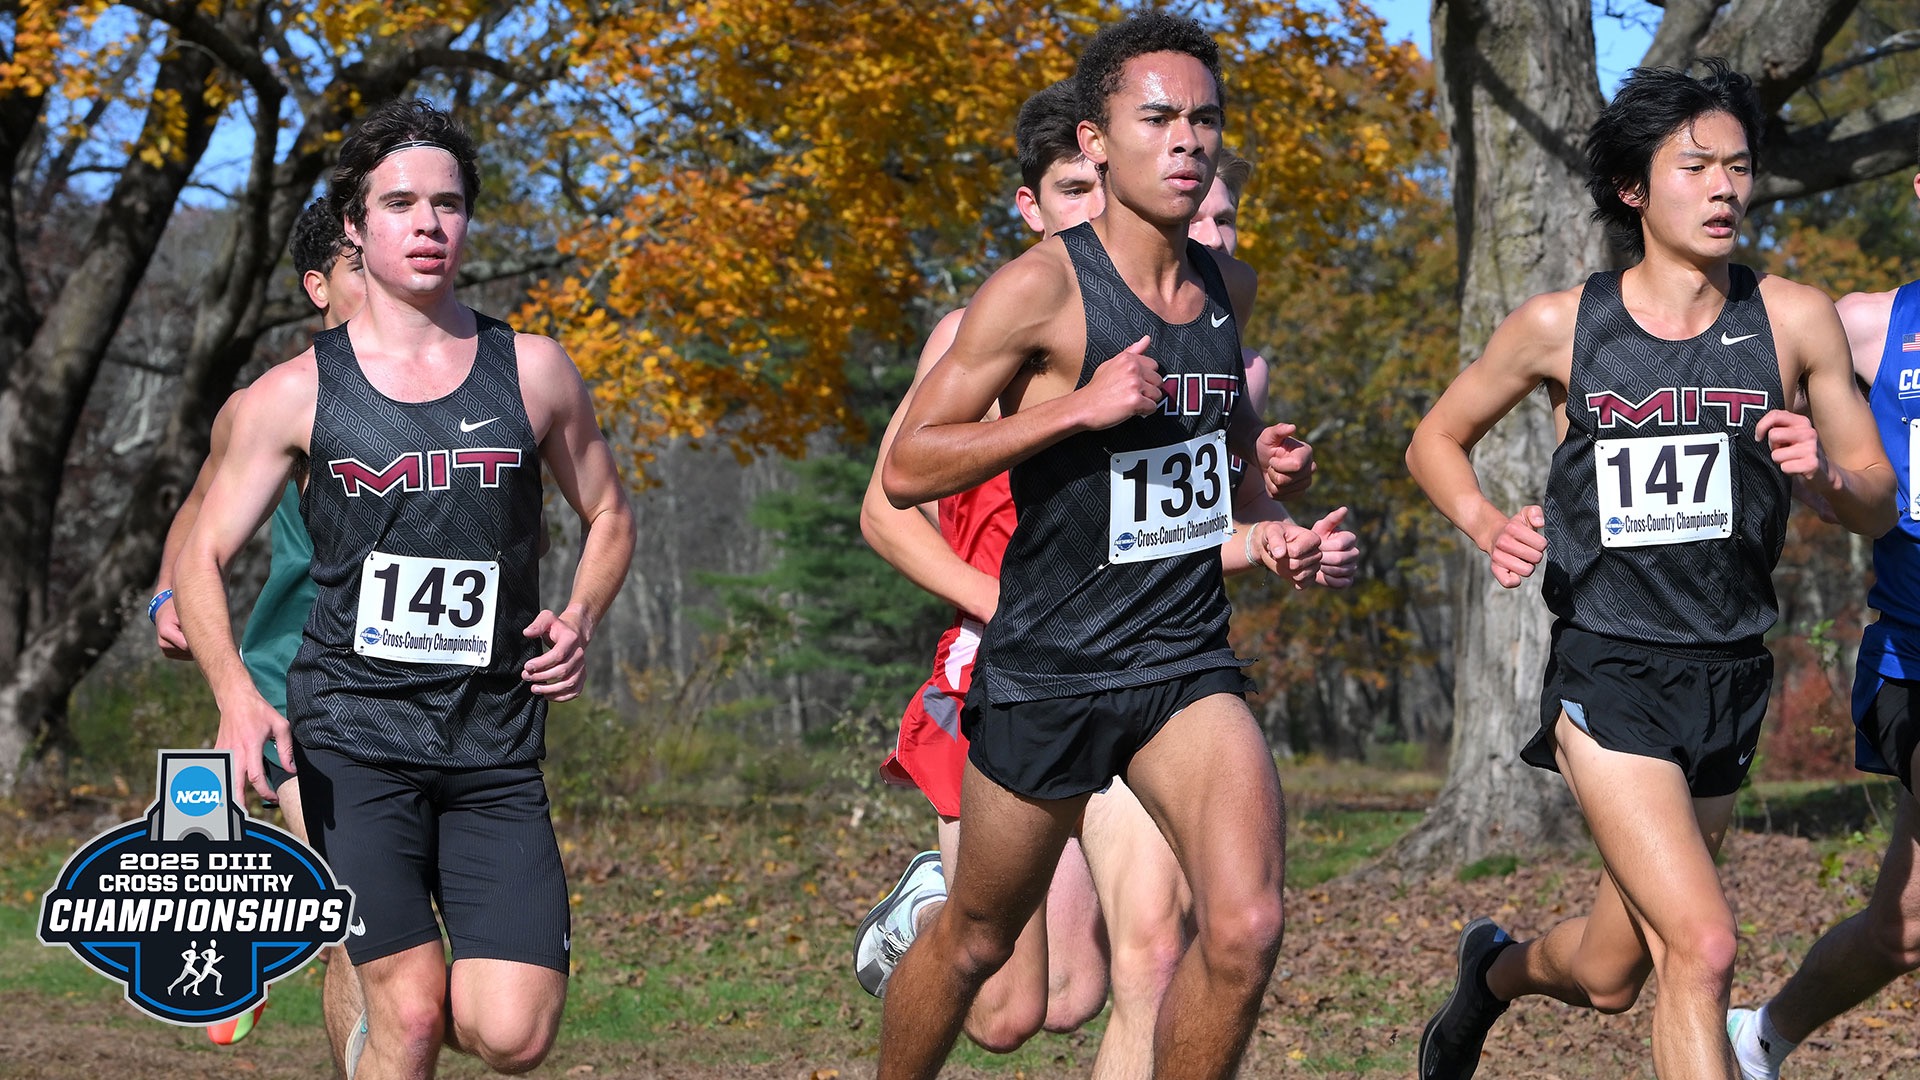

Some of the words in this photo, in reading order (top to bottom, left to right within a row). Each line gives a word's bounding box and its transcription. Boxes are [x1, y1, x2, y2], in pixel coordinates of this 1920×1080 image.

[1585, 387, 1768, 429] MIT
[328, 448, 522, 497] MIT
[1123, 443, 1221, 522] 133
[1607, 443, 1720, 508] 147
[1137, 525, 1187, 548] Cross-Country
[1187, 512, 1229, 539] Championships
[1625, 513, 1675, 533] Cross-Country
[1676, 509, 1729, 531] Championships
[374, 563, 486, 628] 143
[382, 628, 434, 653] Cross-Country
[433, 632, 488, 656] Championships
